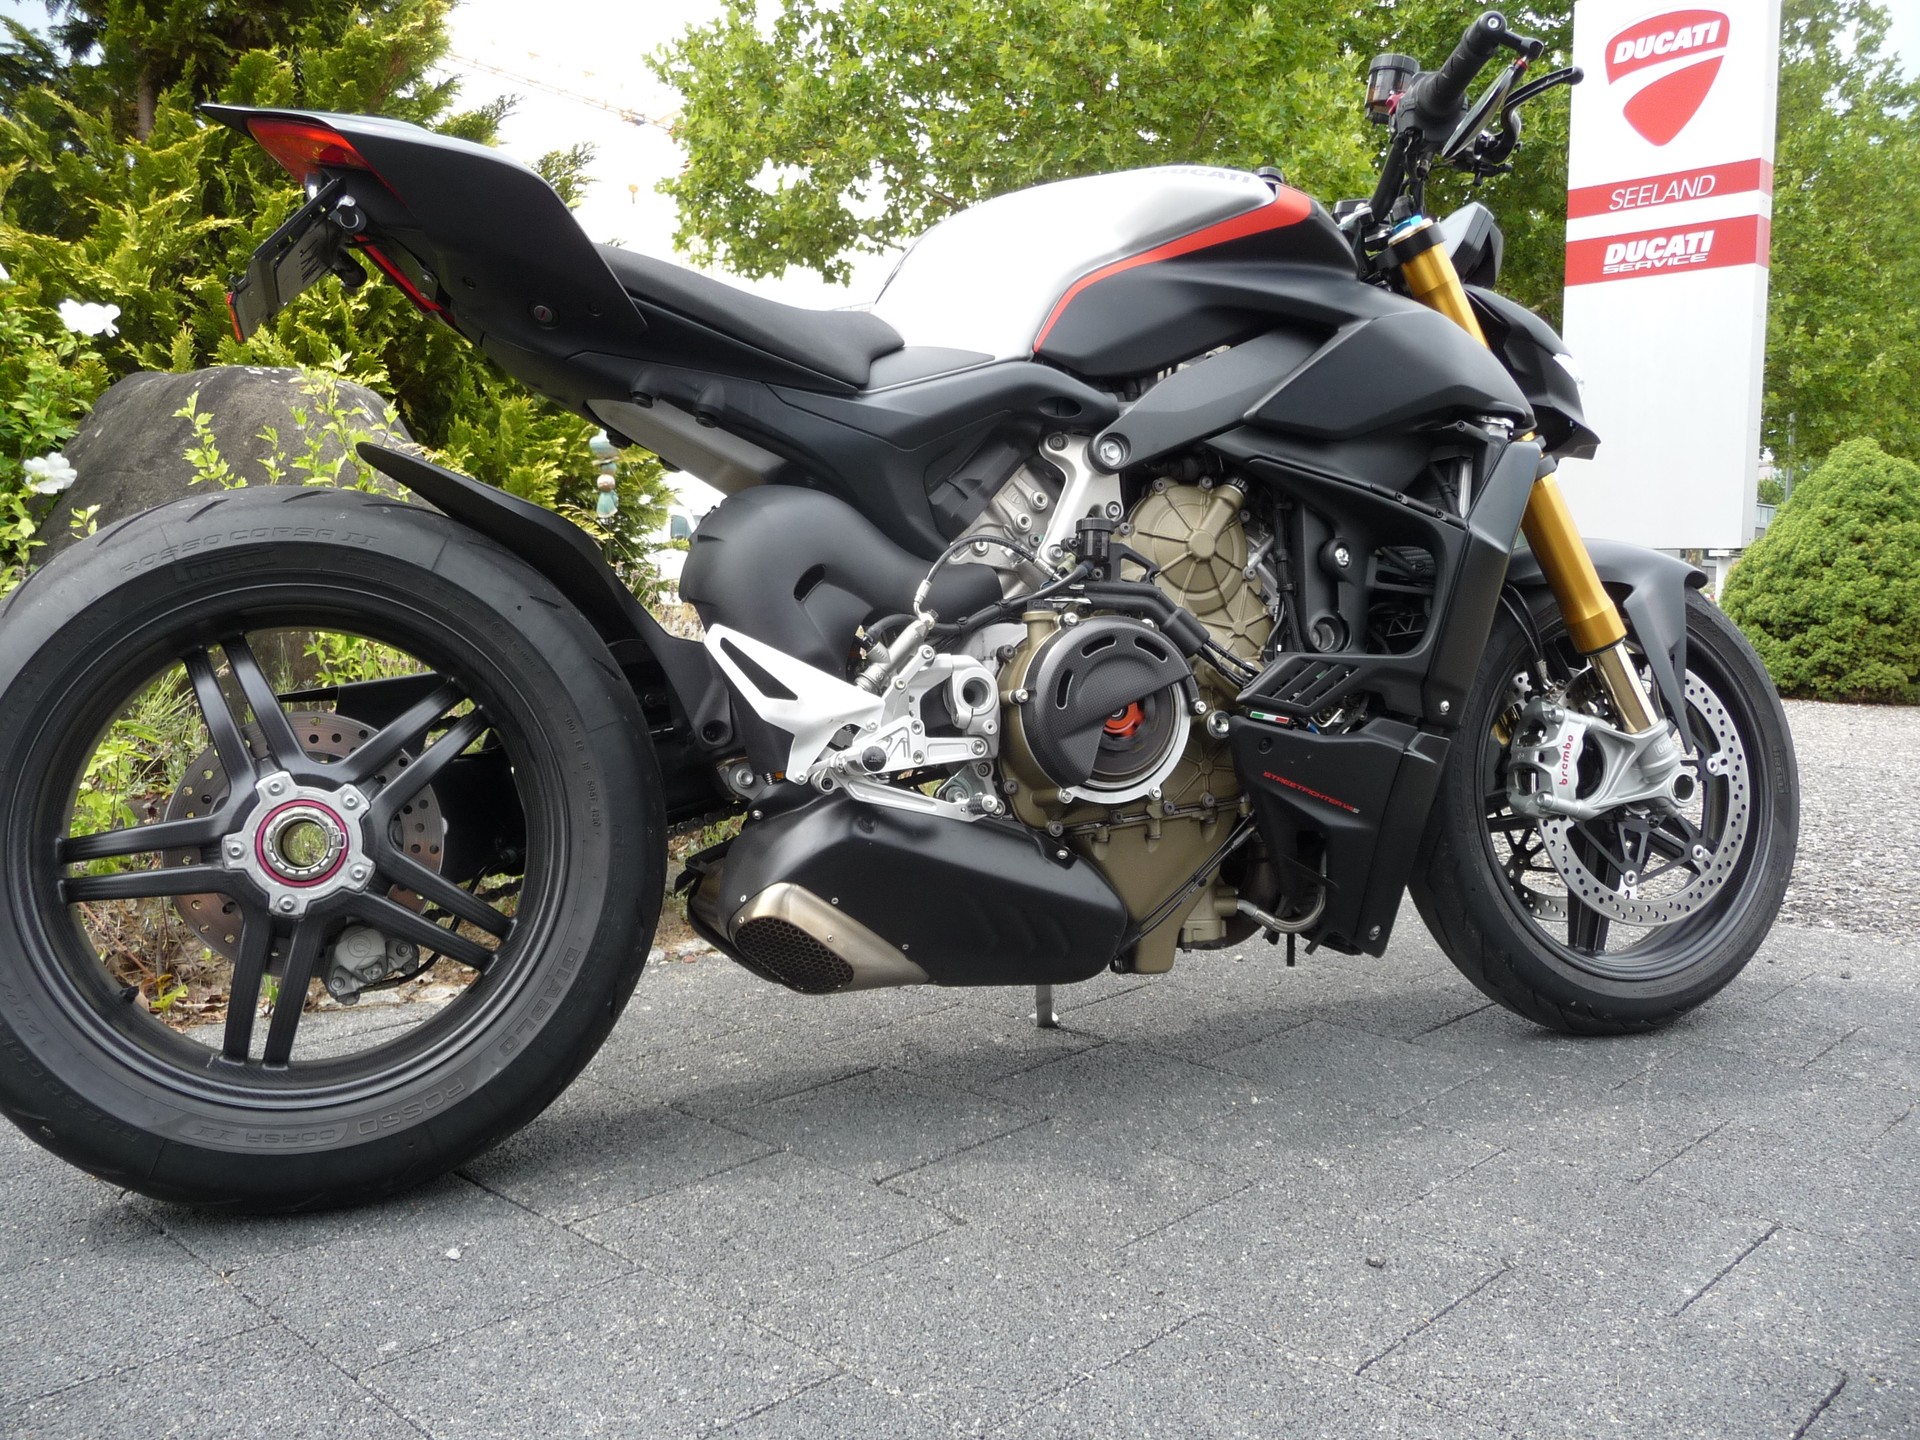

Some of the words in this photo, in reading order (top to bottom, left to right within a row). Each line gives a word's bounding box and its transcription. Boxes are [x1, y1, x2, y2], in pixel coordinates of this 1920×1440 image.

[1613, 20, 1721, 64] DUCATI
[1608, 174, 1716, 211] SEELAND
[1602, 251, 1709, 275] SERVICE
[1604, 230, 1715, 266] DUCATI
[119, 533, 224, 580] ROSSO
[229, 526, 337, 542] CORSA
[1558, 734, 1574, 786] brembo
[1263, 771, 1343, 807] STREETFIGHTER
[500, 945, 583, 1057] DIABLO
[358, 1076, 467, 1136] ROSSO
[244, 1129, 337, 1146] CORSA
